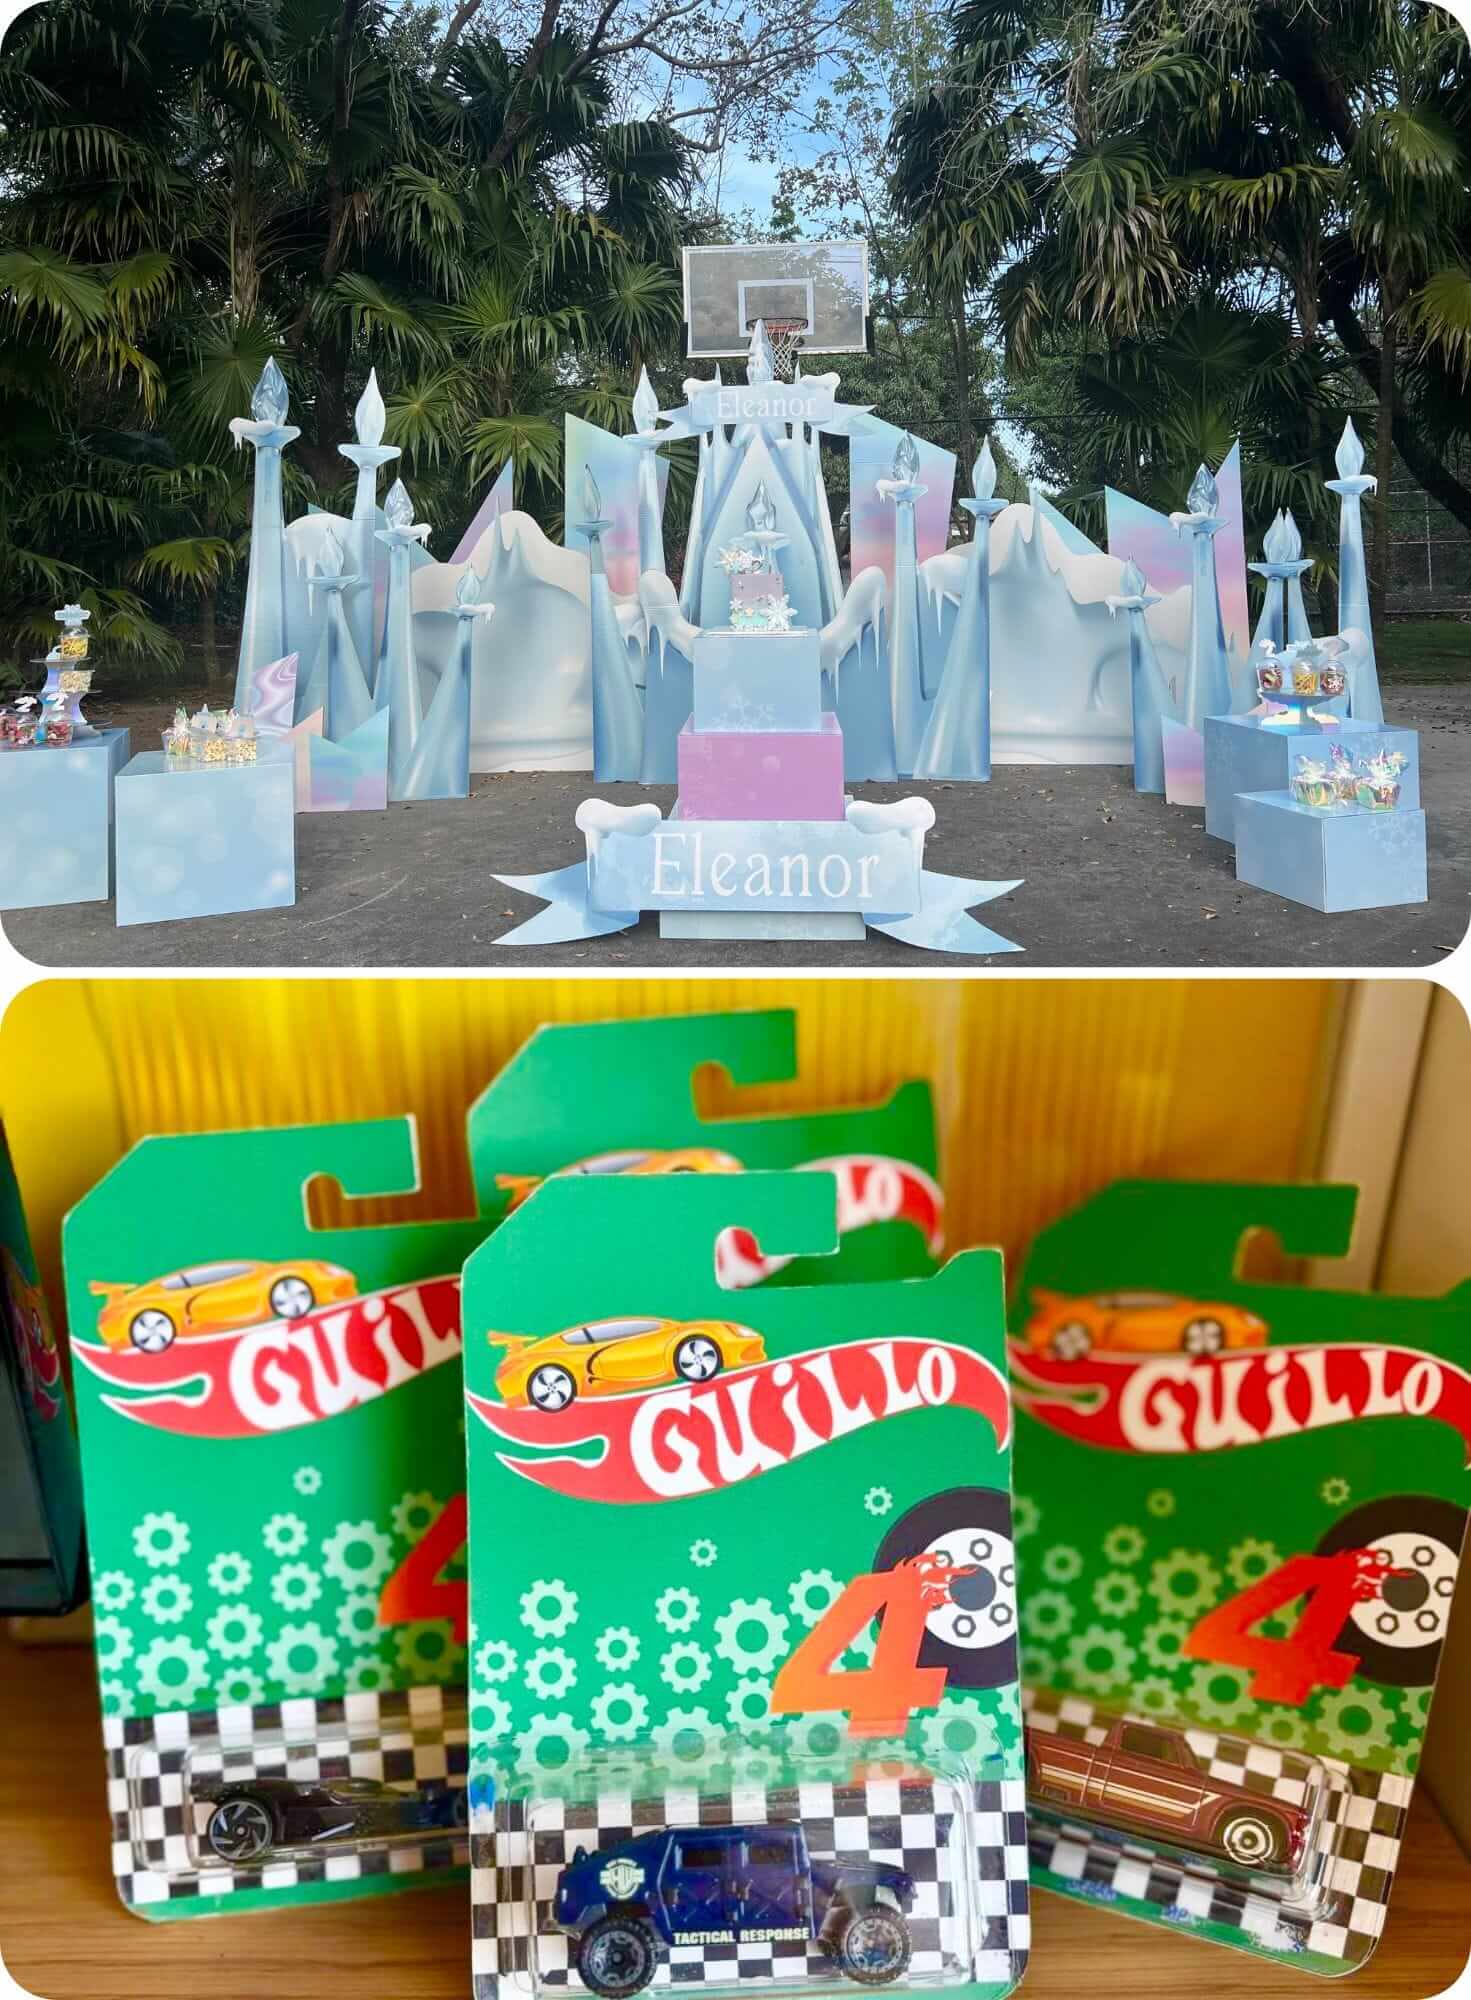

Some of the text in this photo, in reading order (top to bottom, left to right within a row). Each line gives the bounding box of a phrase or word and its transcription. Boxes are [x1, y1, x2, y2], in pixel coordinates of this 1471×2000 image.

[718, 391, 817, 418] Eleanor
[651, 832, 880, 898] Eleanor
[770, 1553, 978, 1738] 4
[1182, 1549, 1385, 1707] 4
[673, 1927, 810, 1945] TACTICAL RESPONSE
